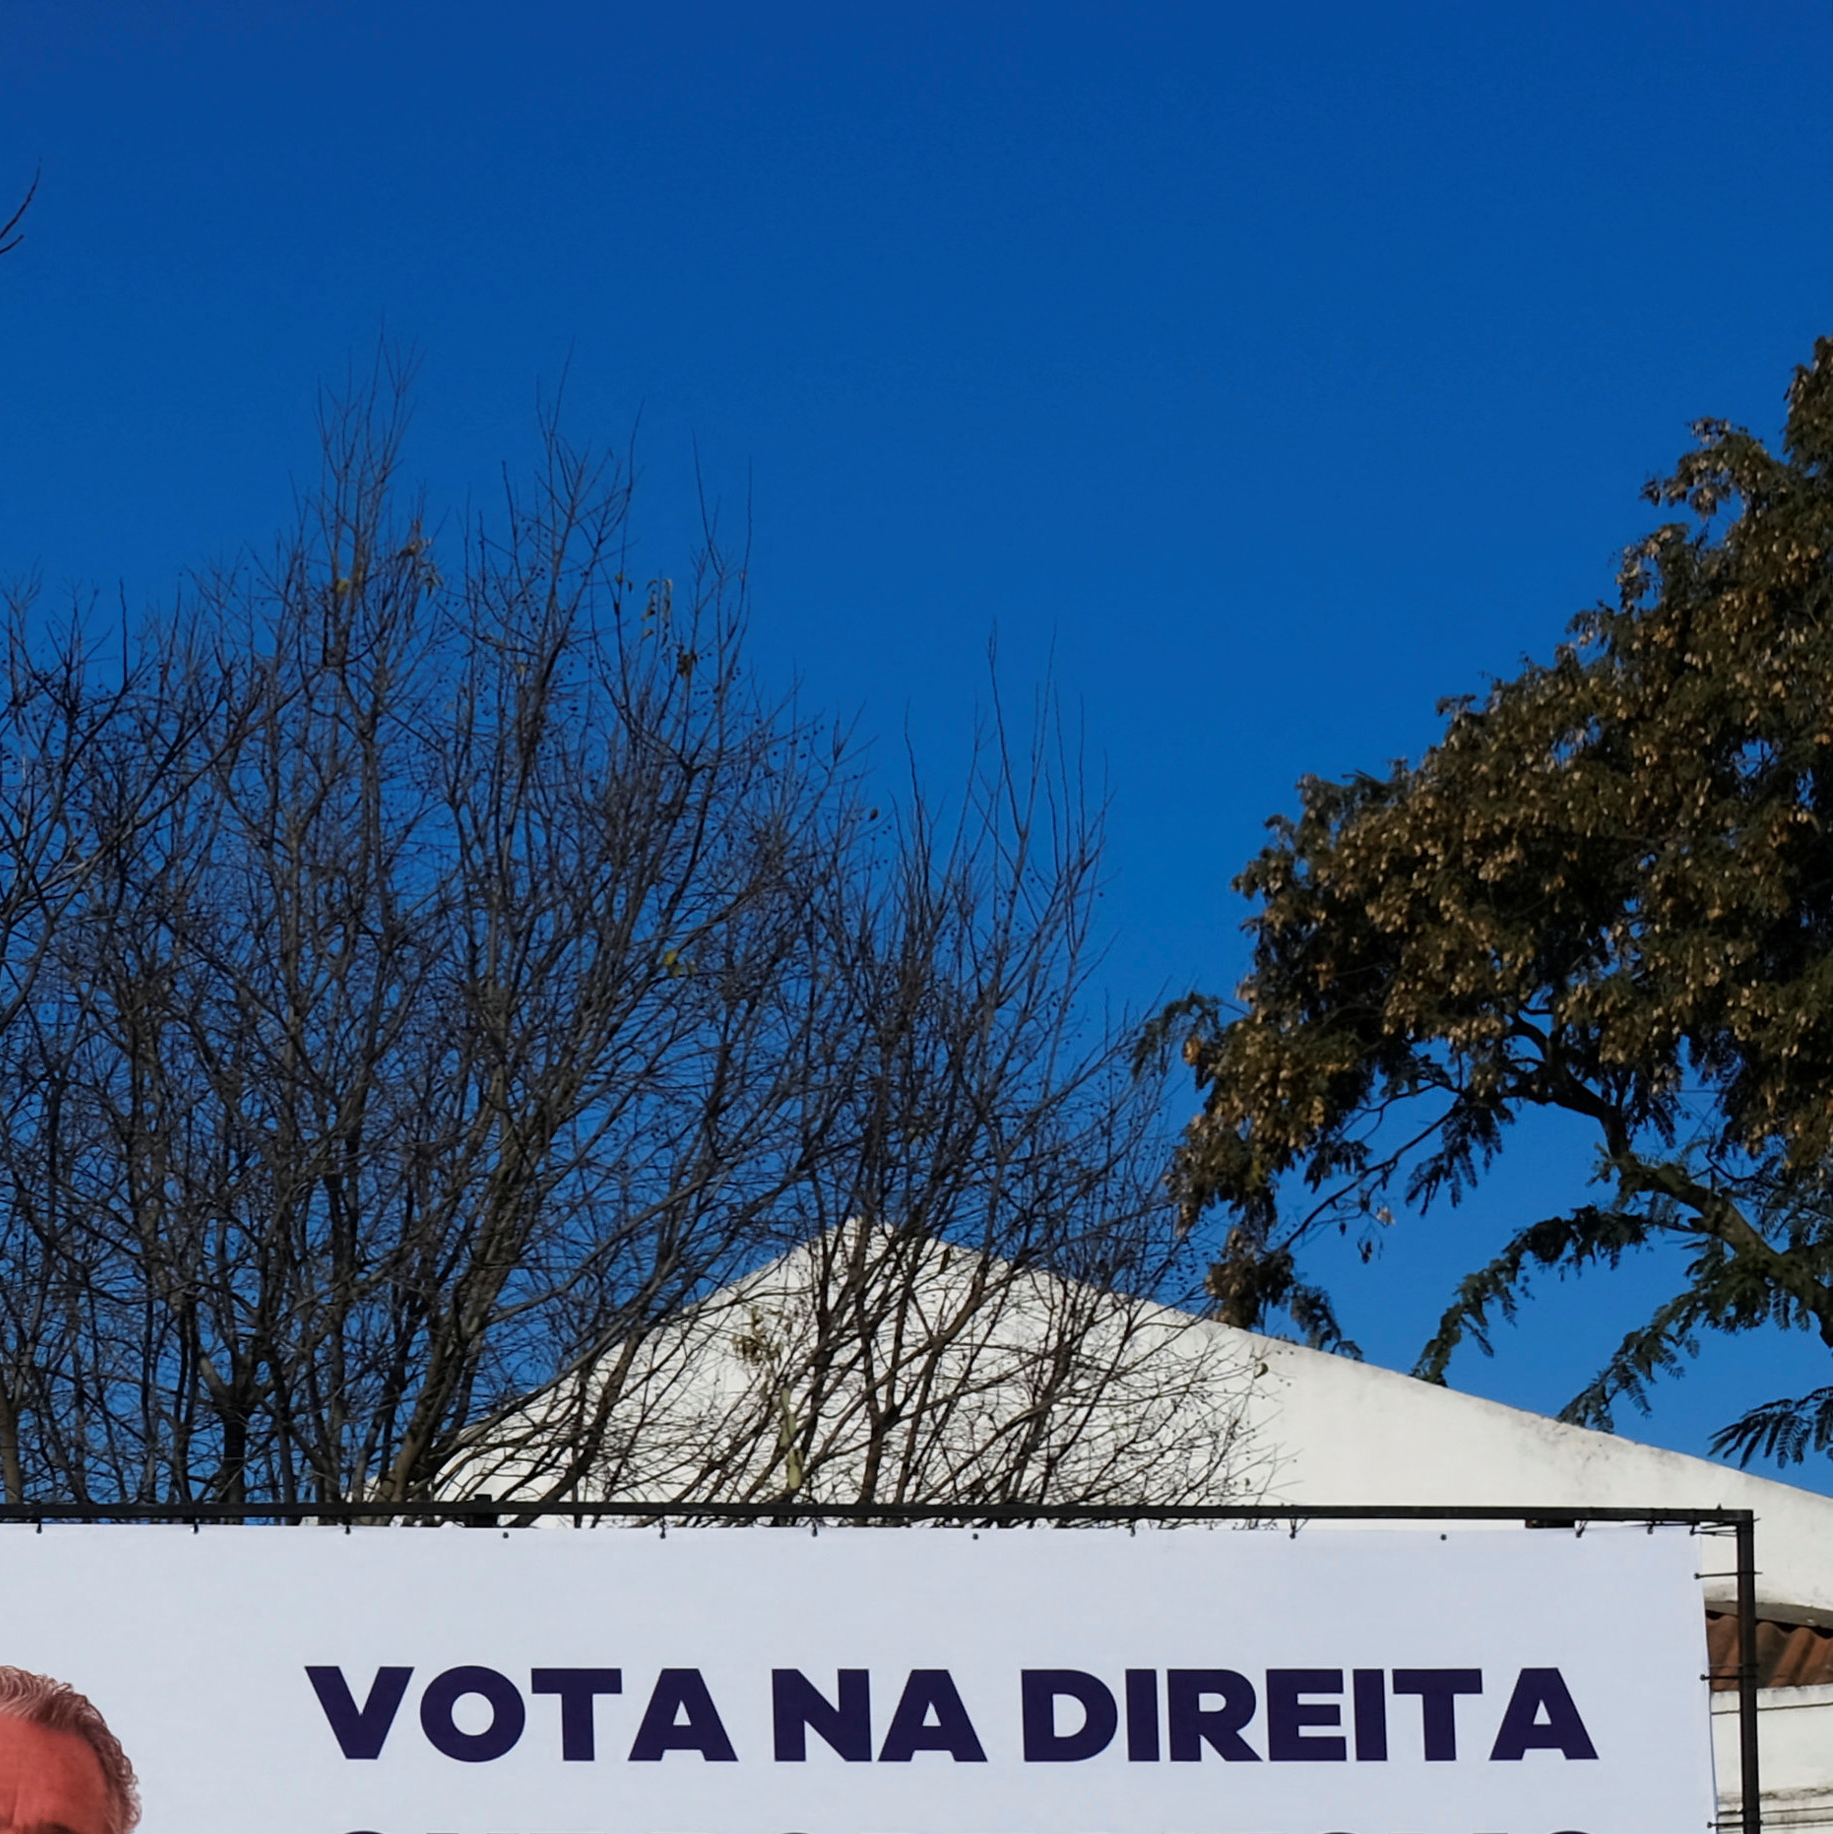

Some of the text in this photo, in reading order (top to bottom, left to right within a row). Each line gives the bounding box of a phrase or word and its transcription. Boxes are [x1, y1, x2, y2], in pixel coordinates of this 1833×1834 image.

[304, 1666, 1599, 1762] VOTA NA DIREITA
